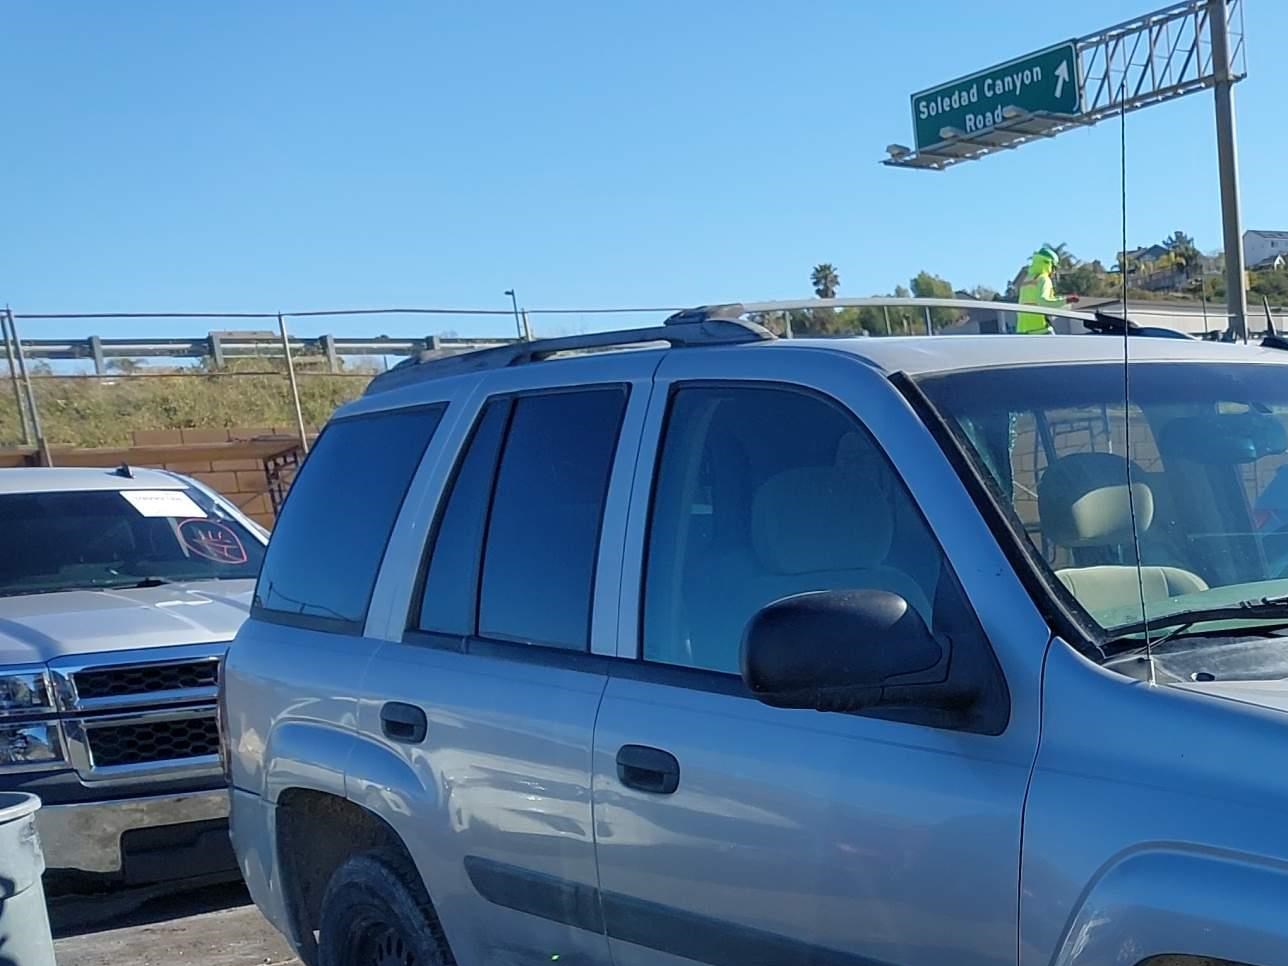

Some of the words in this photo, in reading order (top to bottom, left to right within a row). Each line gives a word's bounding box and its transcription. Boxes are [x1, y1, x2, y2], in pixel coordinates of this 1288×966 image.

[919, 84, 978, 119] Soledad
[984, 66, 1042, 97] Canyon
[965, 104, 1002, 133] Road
